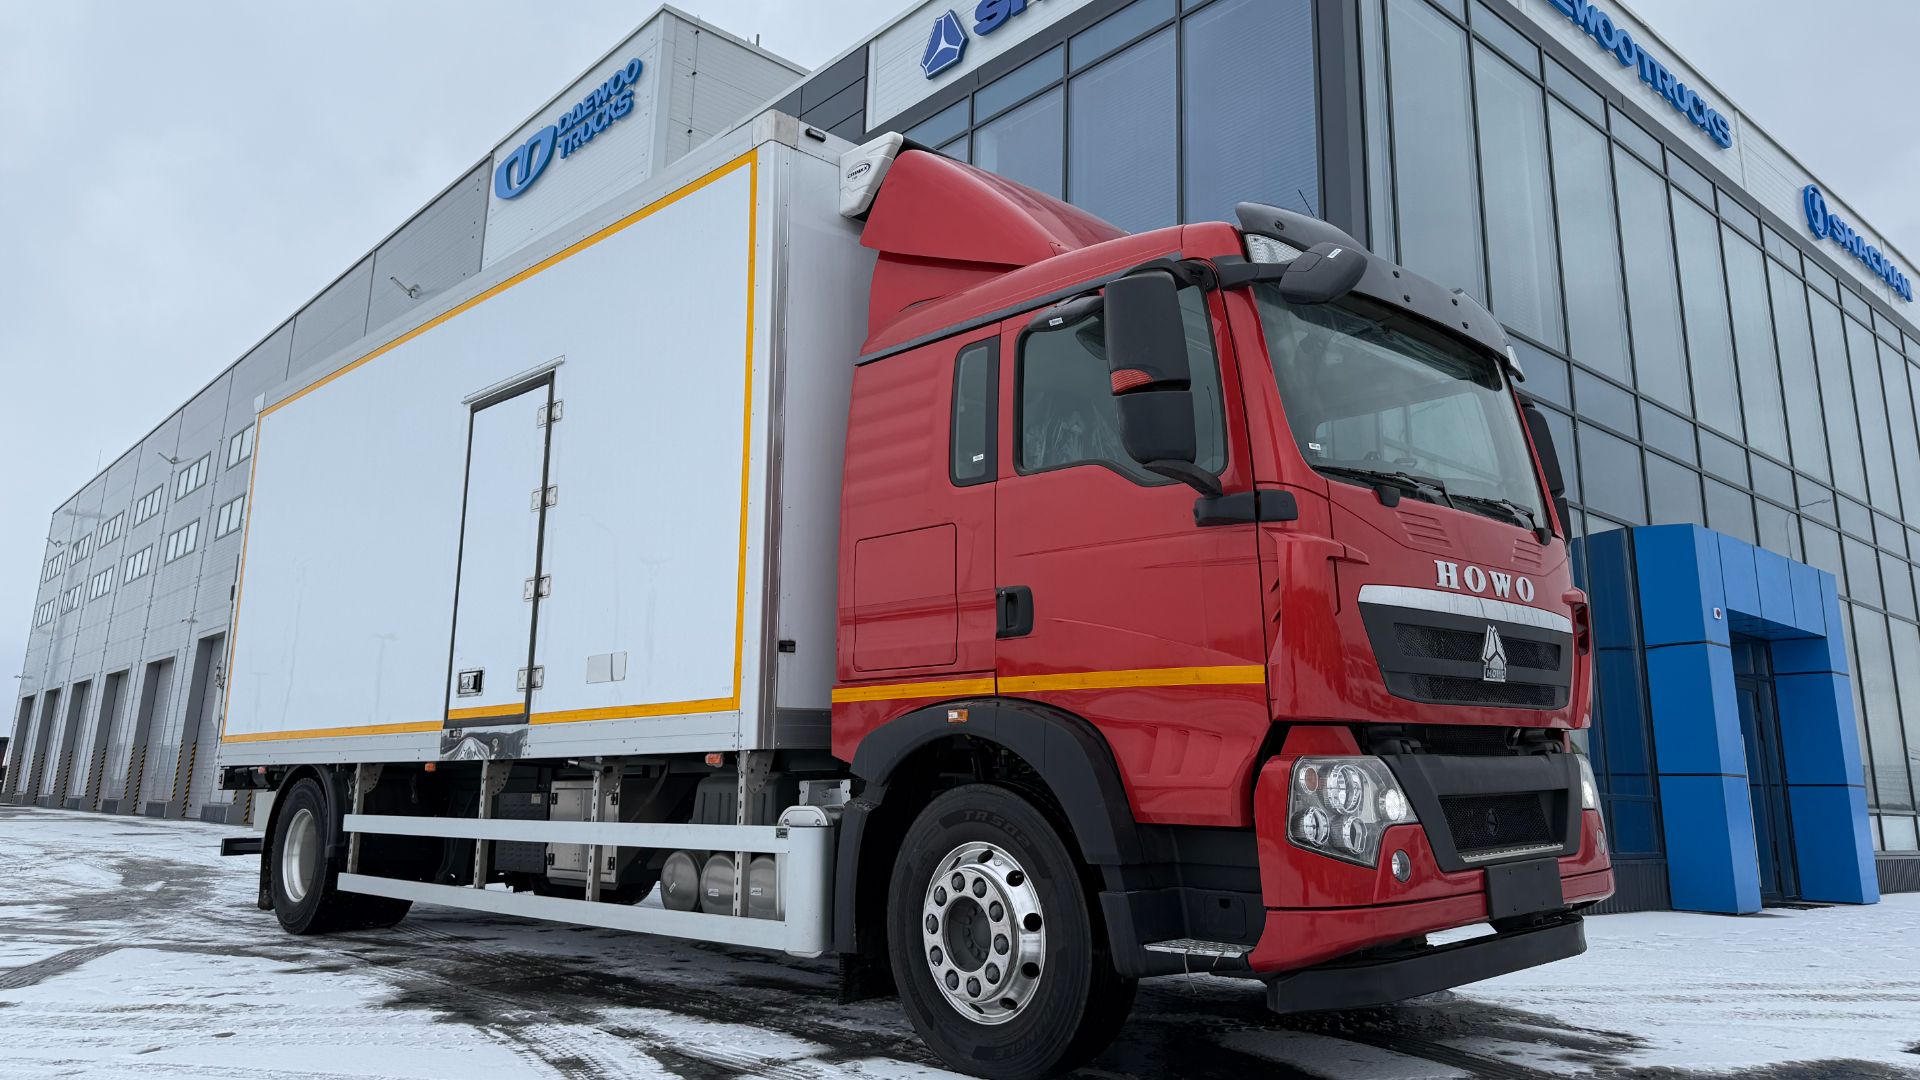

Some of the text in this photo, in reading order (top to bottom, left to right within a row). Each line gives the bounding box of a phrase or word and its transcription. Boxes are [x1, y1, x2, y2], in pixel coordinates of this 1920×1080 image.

[557, 57, 643, 137] DAEWOO
[1548, 0, 1733, 149] WOO TRUCKS
[557, 89, 634, 159] TRUCKS
[1828, 213, 1913, 302] SHACMAN
[1434, 559, 1535, 603] HOWO
